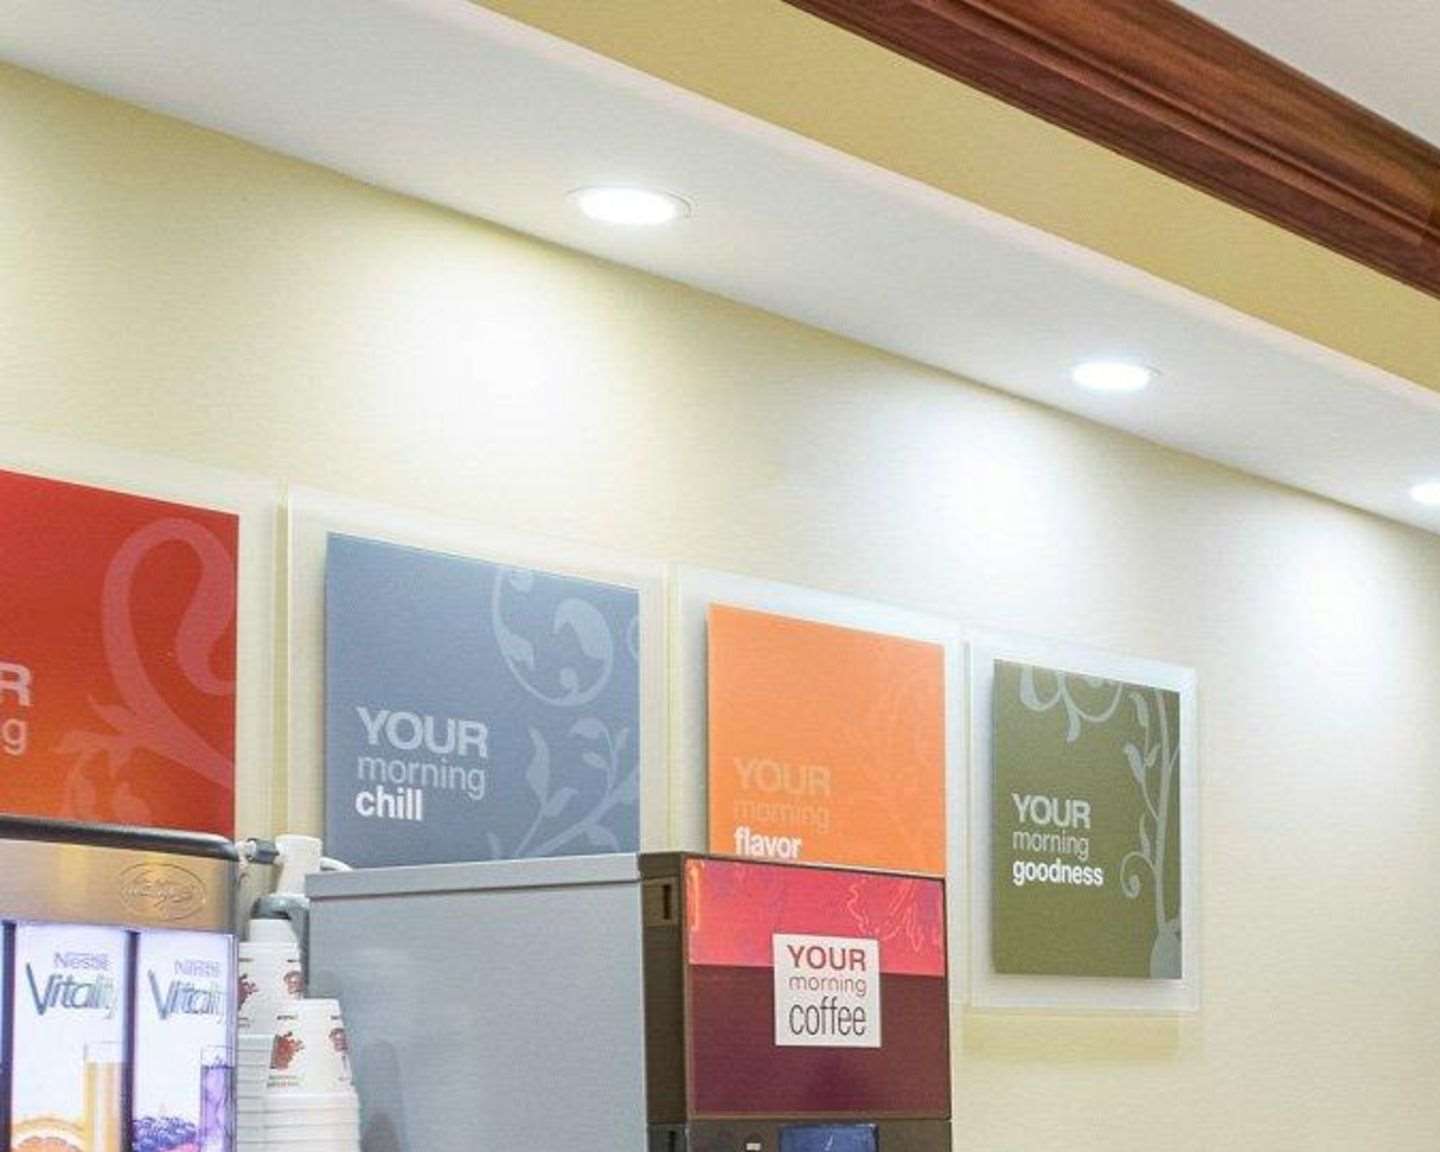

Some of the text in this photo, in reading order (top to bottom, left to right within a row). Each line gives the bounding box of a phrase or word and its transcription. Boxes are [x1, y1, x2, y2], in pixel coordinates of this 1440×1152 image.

[356, 706, 488, 758] YOUR
[357, 756, 486, 801] morning
[734, 758, 831, 796] YOUR
[355, 785, 422, 821] chill
[1011, 792, 1091, 829] YOUR
[734, 825, 802, 859] flavor
[1012, 829, 1089, 861] morning
[1013, 857, 1104, 886] goodness
[787, 944, 866, 971] YOUR
[788, 976, 867, 997] morning
[789, 995, 867, 1036] coffee
